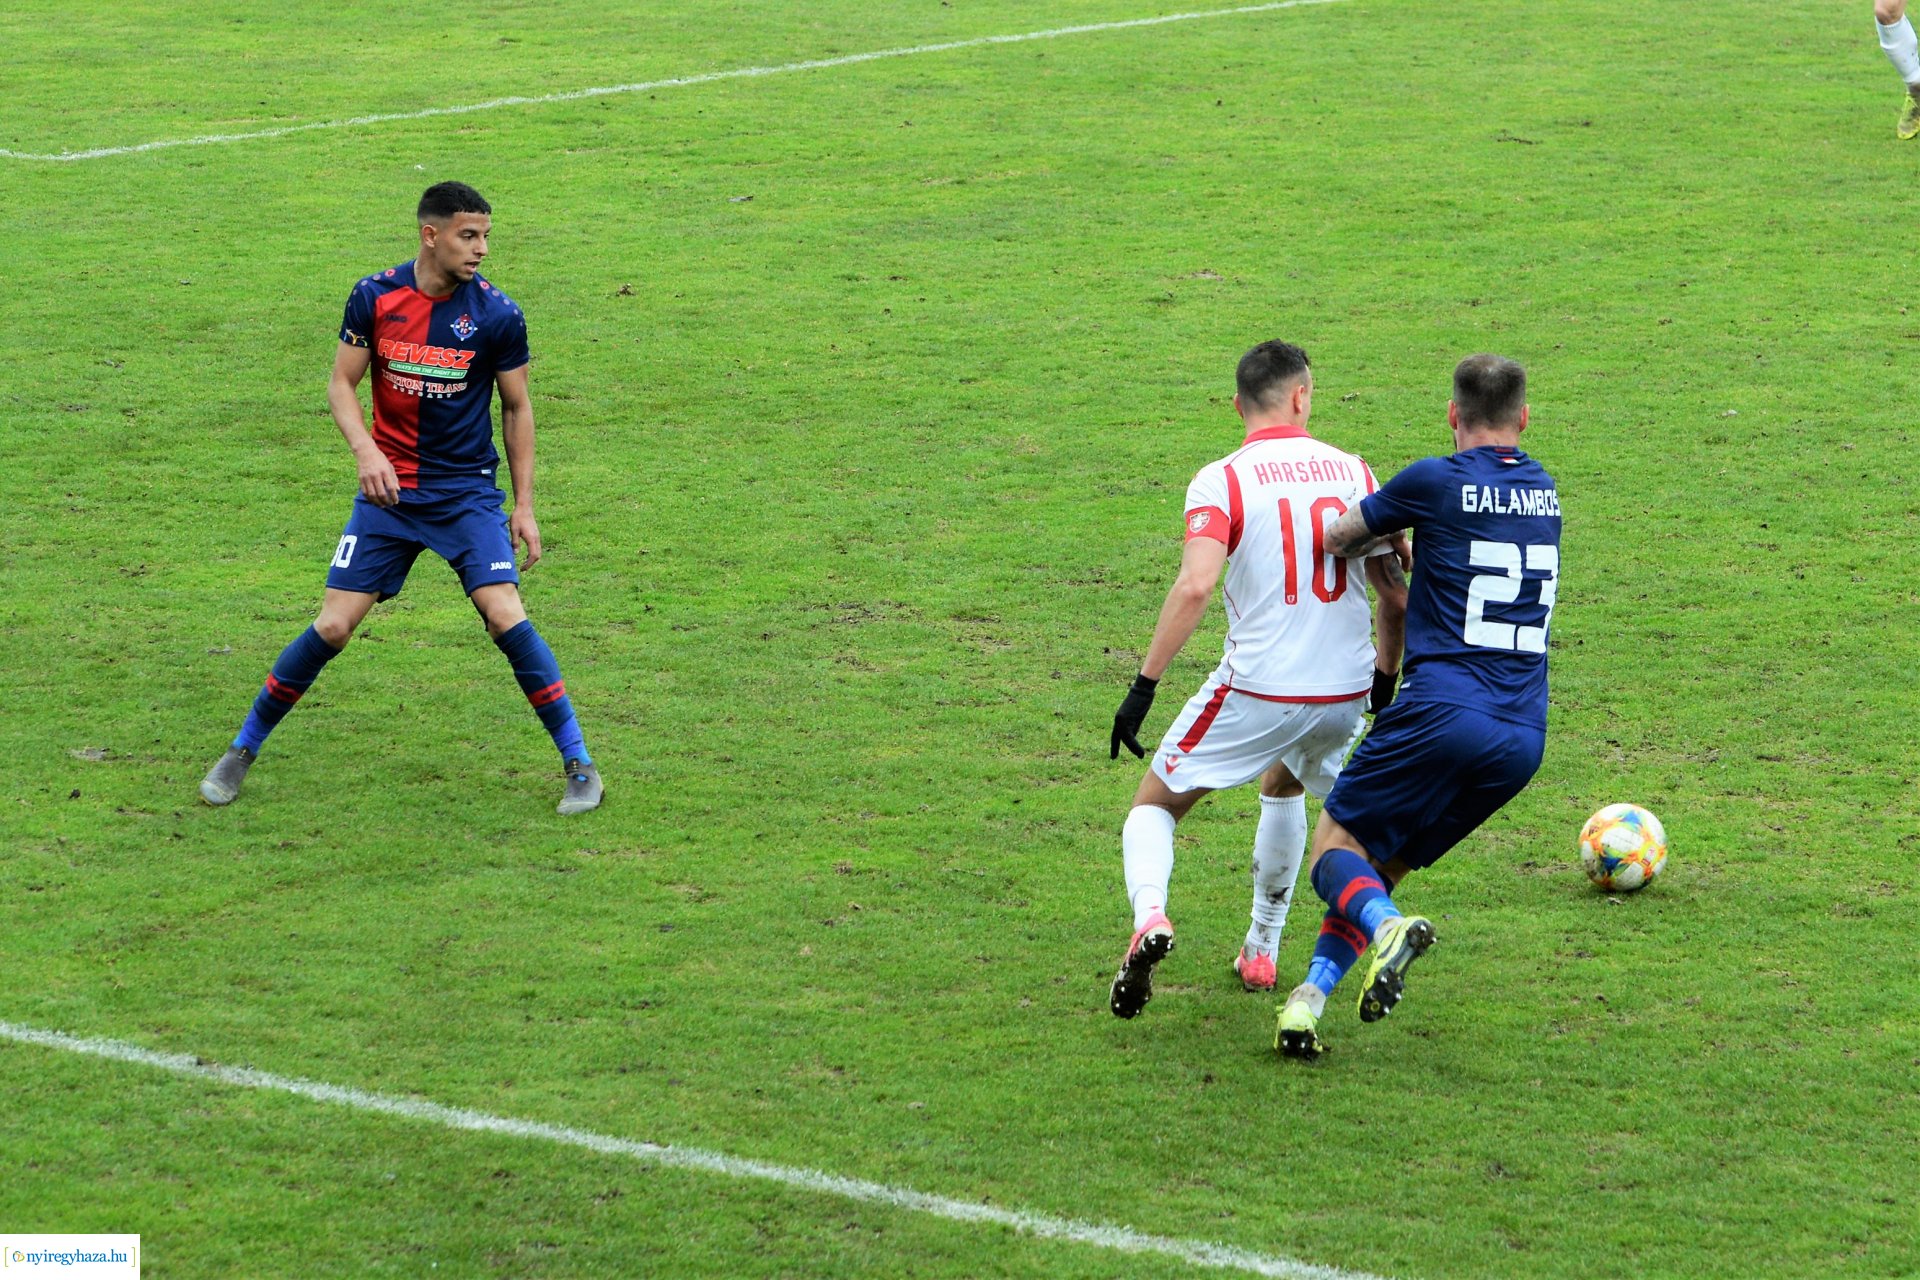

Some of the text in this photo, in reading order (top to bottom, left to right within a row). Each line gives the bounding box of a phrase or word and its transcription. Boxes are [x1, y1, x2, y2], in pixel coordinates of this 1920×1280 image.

[1253, 455, 1354, 485] HARSÁNYI
[1462, 485, 1560, 516] GALAMBOS
[490, 561, 512, 570] JAKO
[1278, 497, 1348, 605] 10
[1464, 540, 1559, 653] 23
